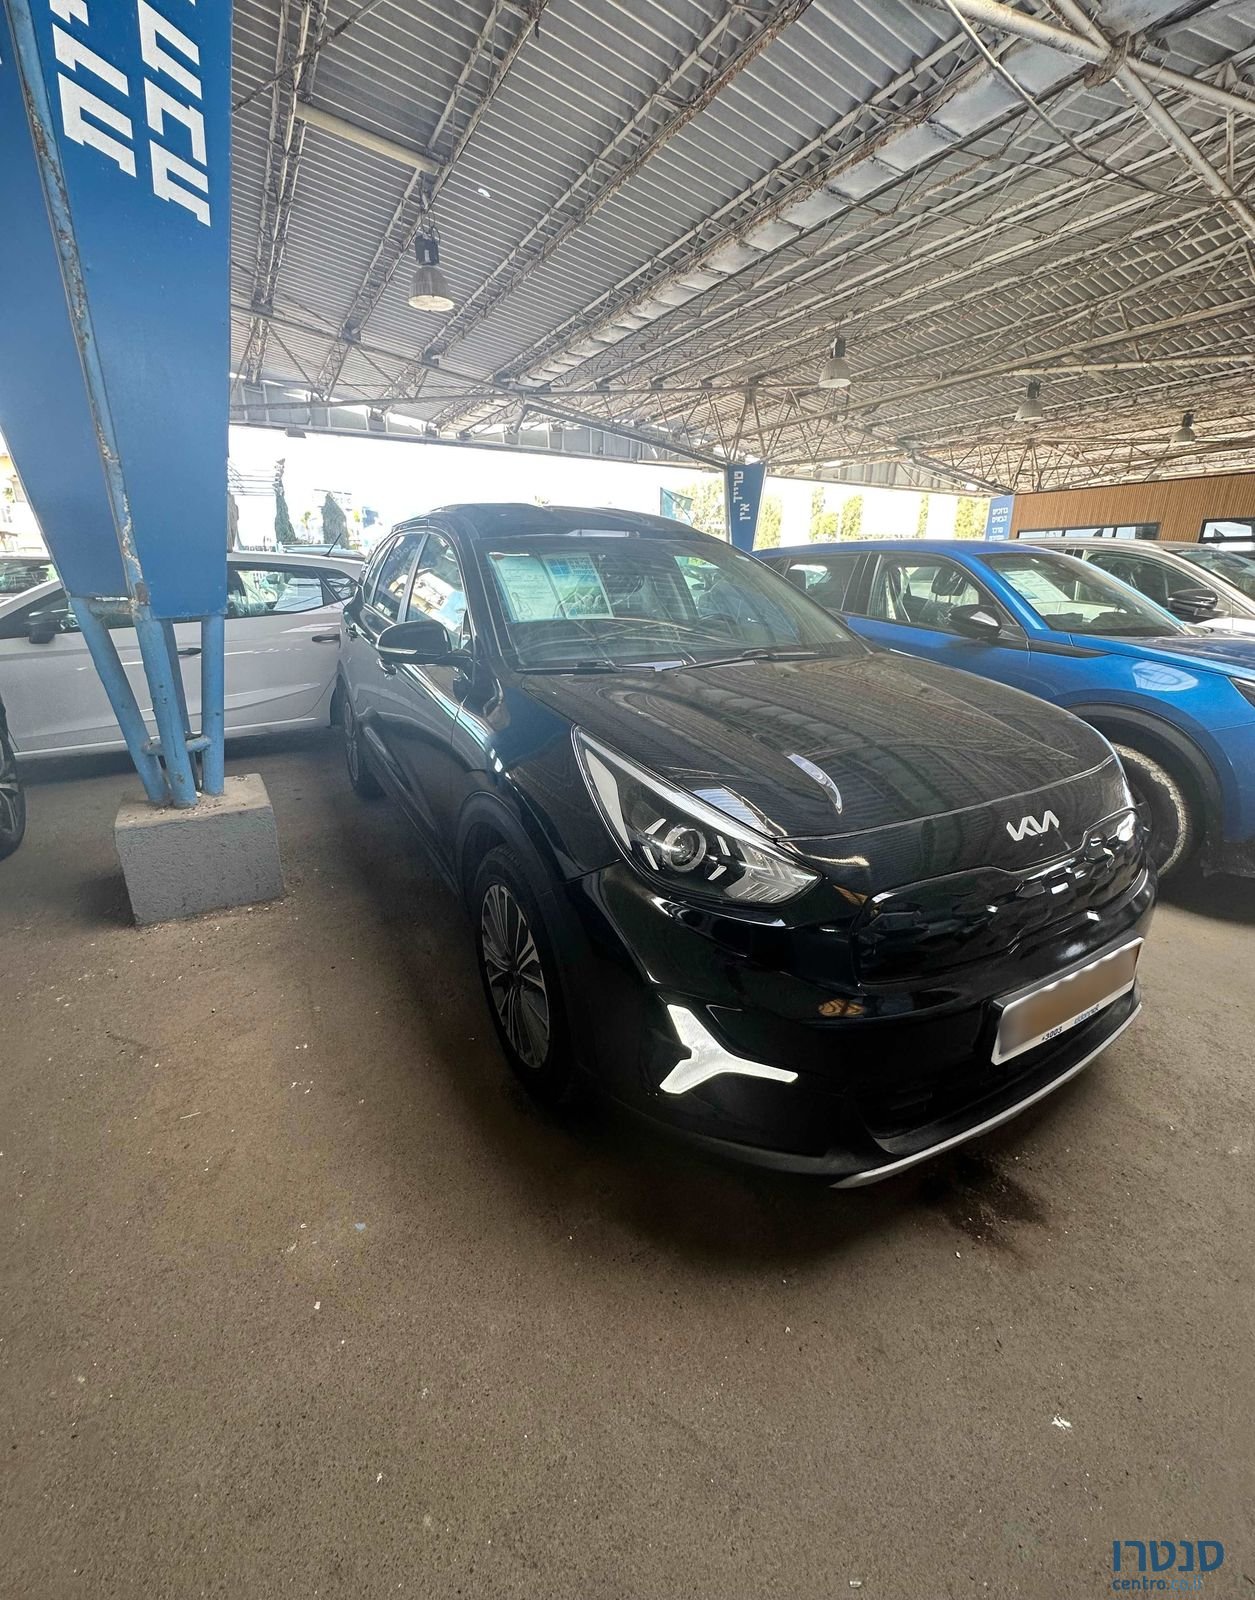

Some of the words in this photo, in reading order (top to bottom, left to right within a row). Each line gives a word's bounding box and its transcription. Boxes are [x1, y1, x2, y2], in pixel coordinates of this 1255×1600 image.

[138, 0, 211, 227] חבת
[740, 503, 751, 521] אין
[1006, 810, 1060, 841] KIA
